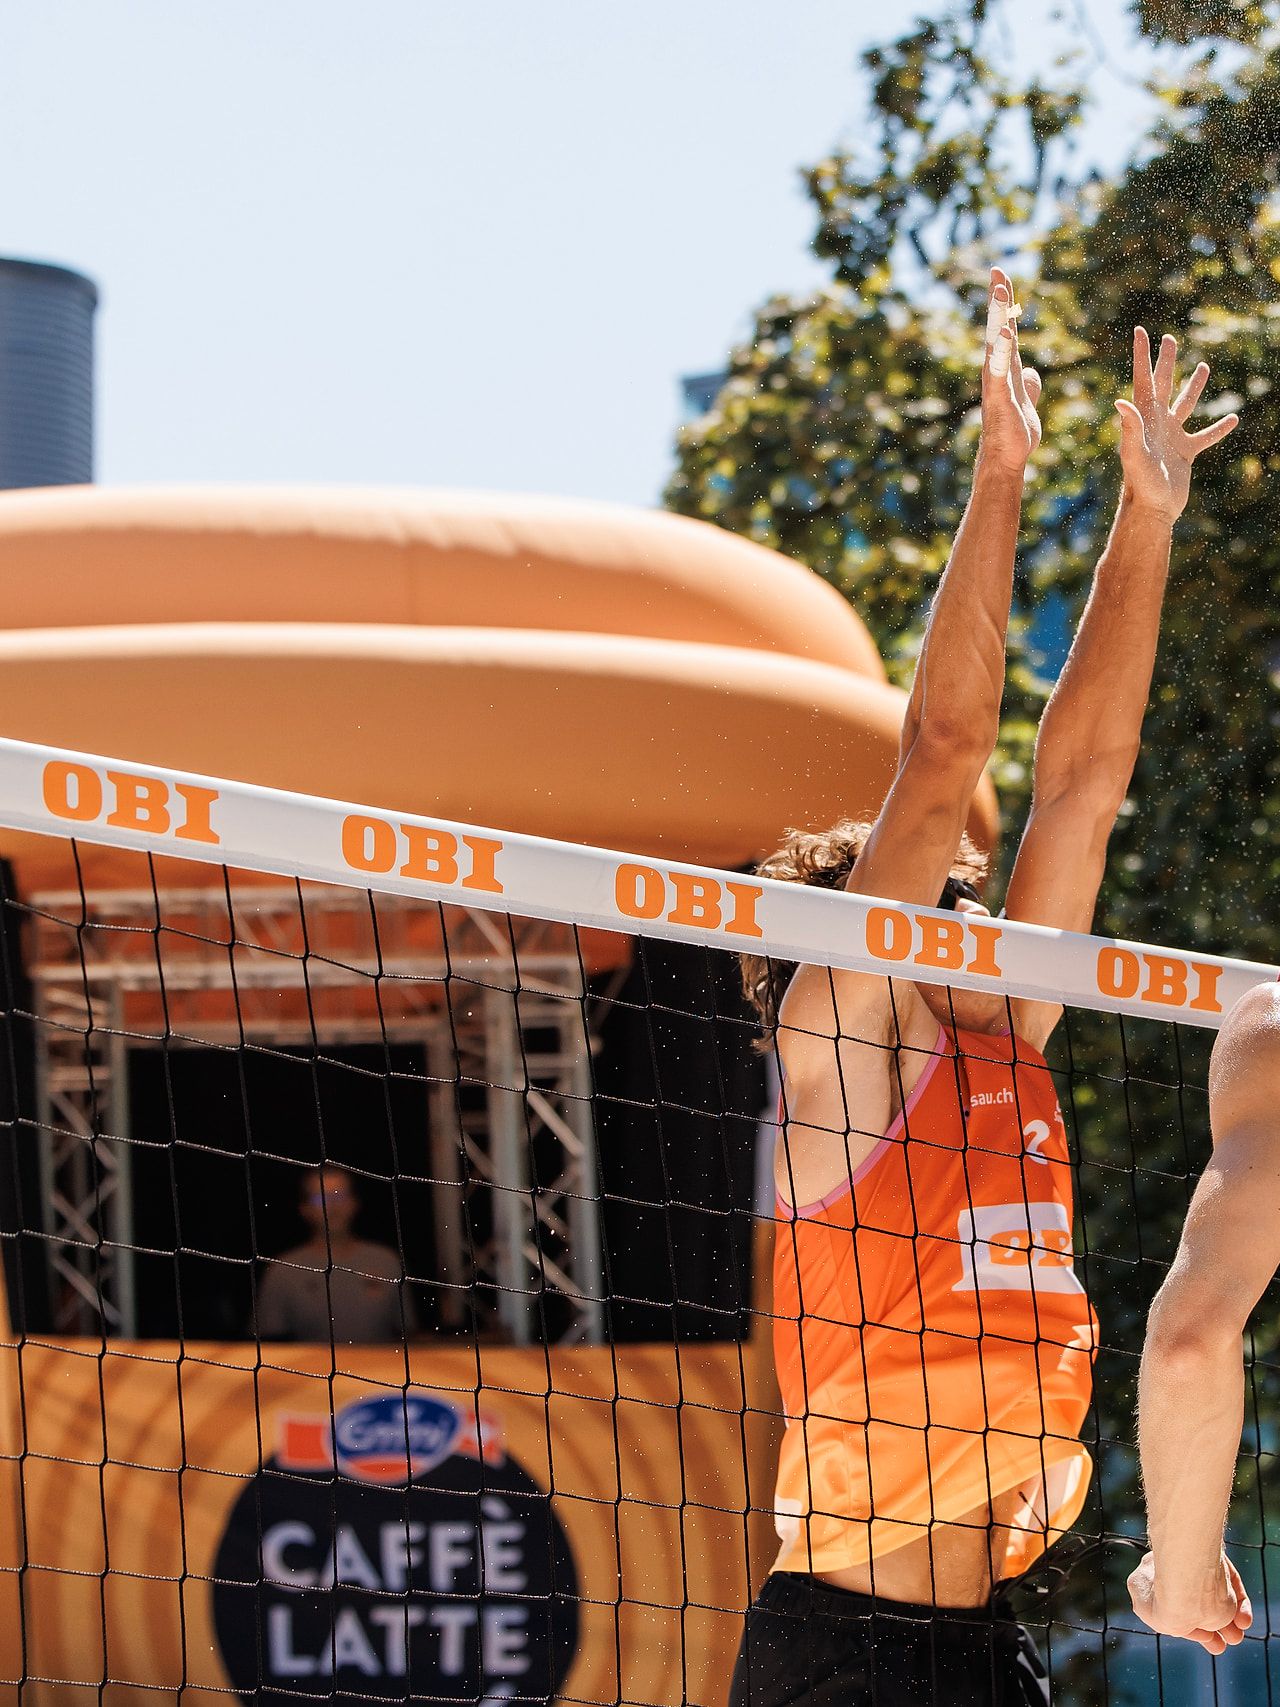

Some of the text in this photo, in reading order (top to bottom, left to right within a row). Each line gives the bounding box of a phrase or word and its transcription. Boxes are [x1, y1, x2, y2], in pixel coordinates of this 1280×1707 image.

[42, 760, 220, 845] OBI
[341, 814, 504, 894] OBI
[615, 863, 764, 939] OBI
[866, 906, 1002, 978] OBI
[1097, 946, 1223, 1013] OBI
[970, 1087, 1014, 1108] sau.ch
[261, 1497, 528, 1593] CAFFÈ
[267, 1603, 532, 1677] LATTE
